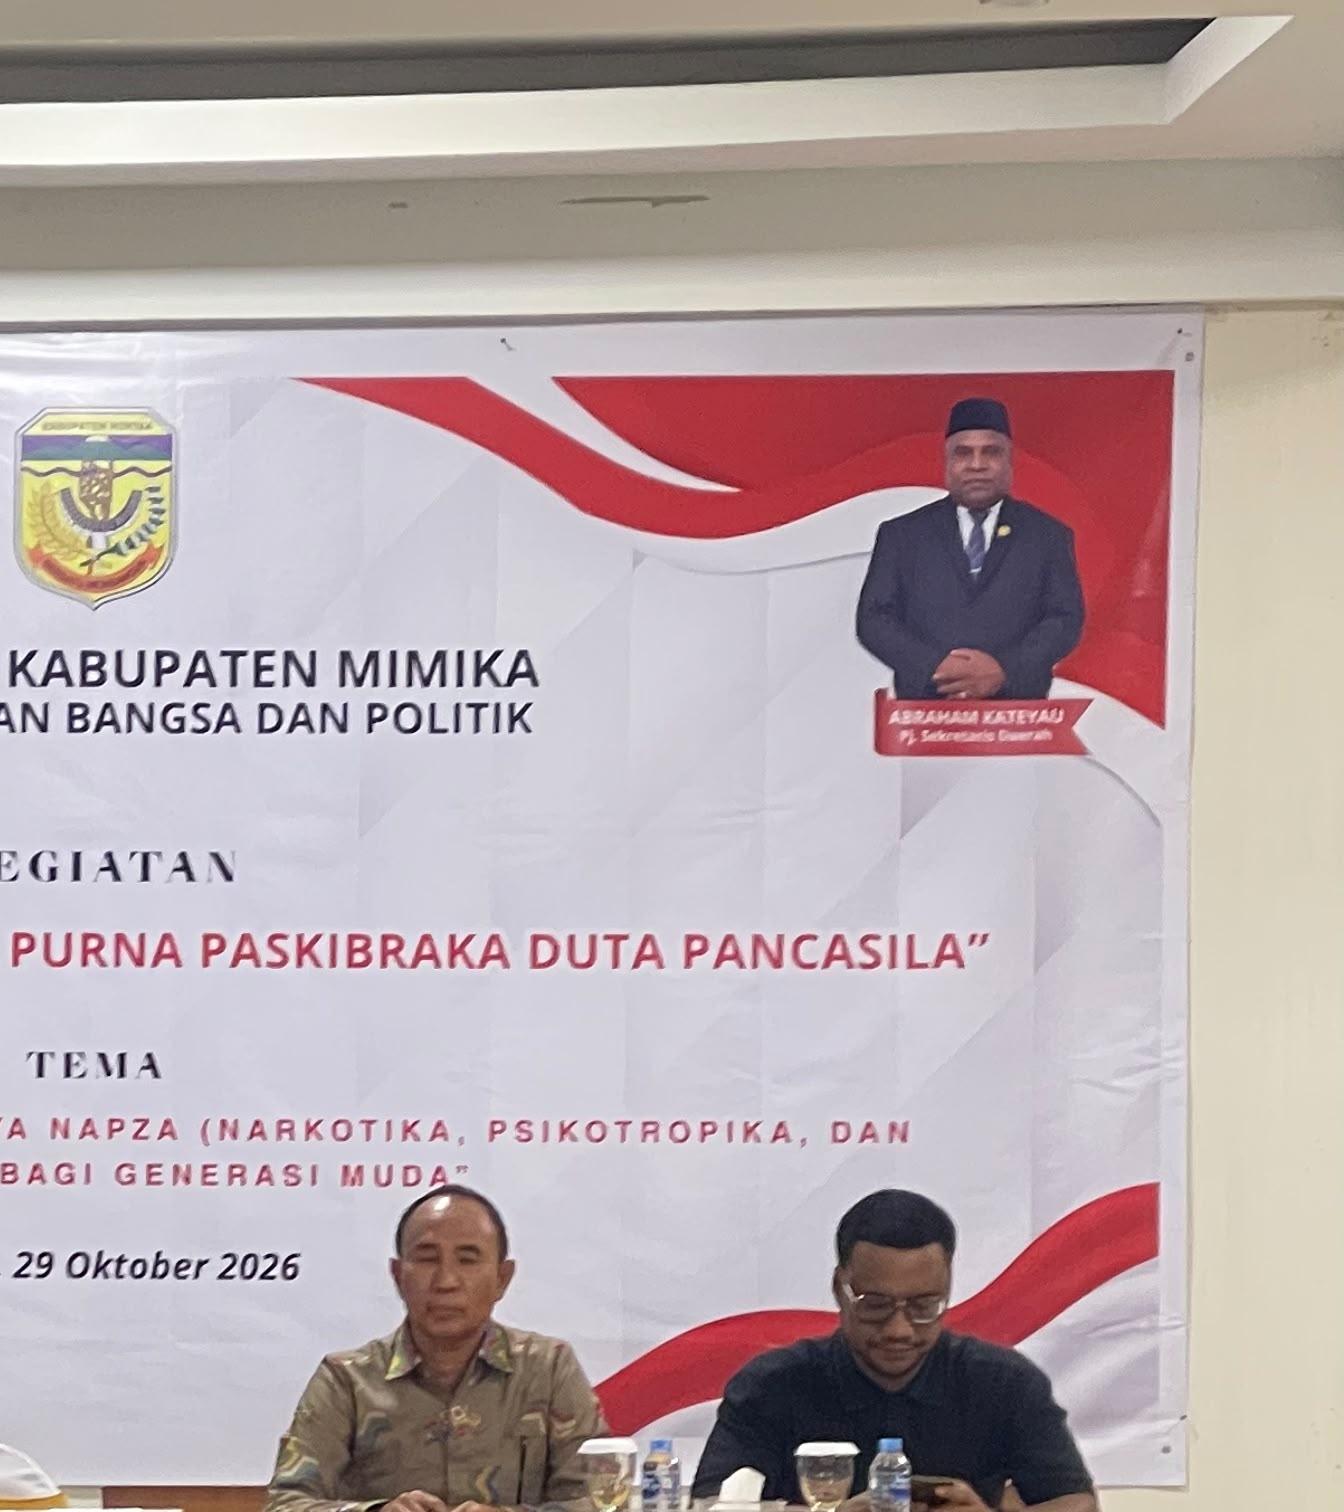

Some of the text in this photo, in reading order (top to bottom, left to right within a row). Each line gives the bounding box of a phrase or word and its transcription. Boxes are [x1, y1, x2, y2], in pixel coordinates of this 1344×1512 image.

[8, 649, 317, 688] KABUPATEN
[338, 649, 540, 688] MIMIKA
[66, 702, 243, 735] BANGSA
[257, 702, 349, 735] DAN
[366, 701, 534, 735] POLITIK
[888, 709, 979, 725] ABRAHAM
[11, 931, 183, 969] PURNA
[201, 932, 511, 970] PASKIBRAKA
[529, 933, 665, 970] DUTA
[26, 1051, 161, 1080] TEMA
[50, 1117, 178, 1141] NAPZA
[200, 1118, 465, 1147] (NARKOTIKA,
[488, 1119, 807, 1148] PSIKOTROPIKA,
[831, 1120, 909, 1144] DAN
[0, 1162, 91, 1186] BAGI
[114, 1162, 318, 1187] GENERASI
[12, 1251, 54, 1279] 29
[65, 1249, 210, 1281] Oktober
[216, 1252, 301, 1281] 2026
